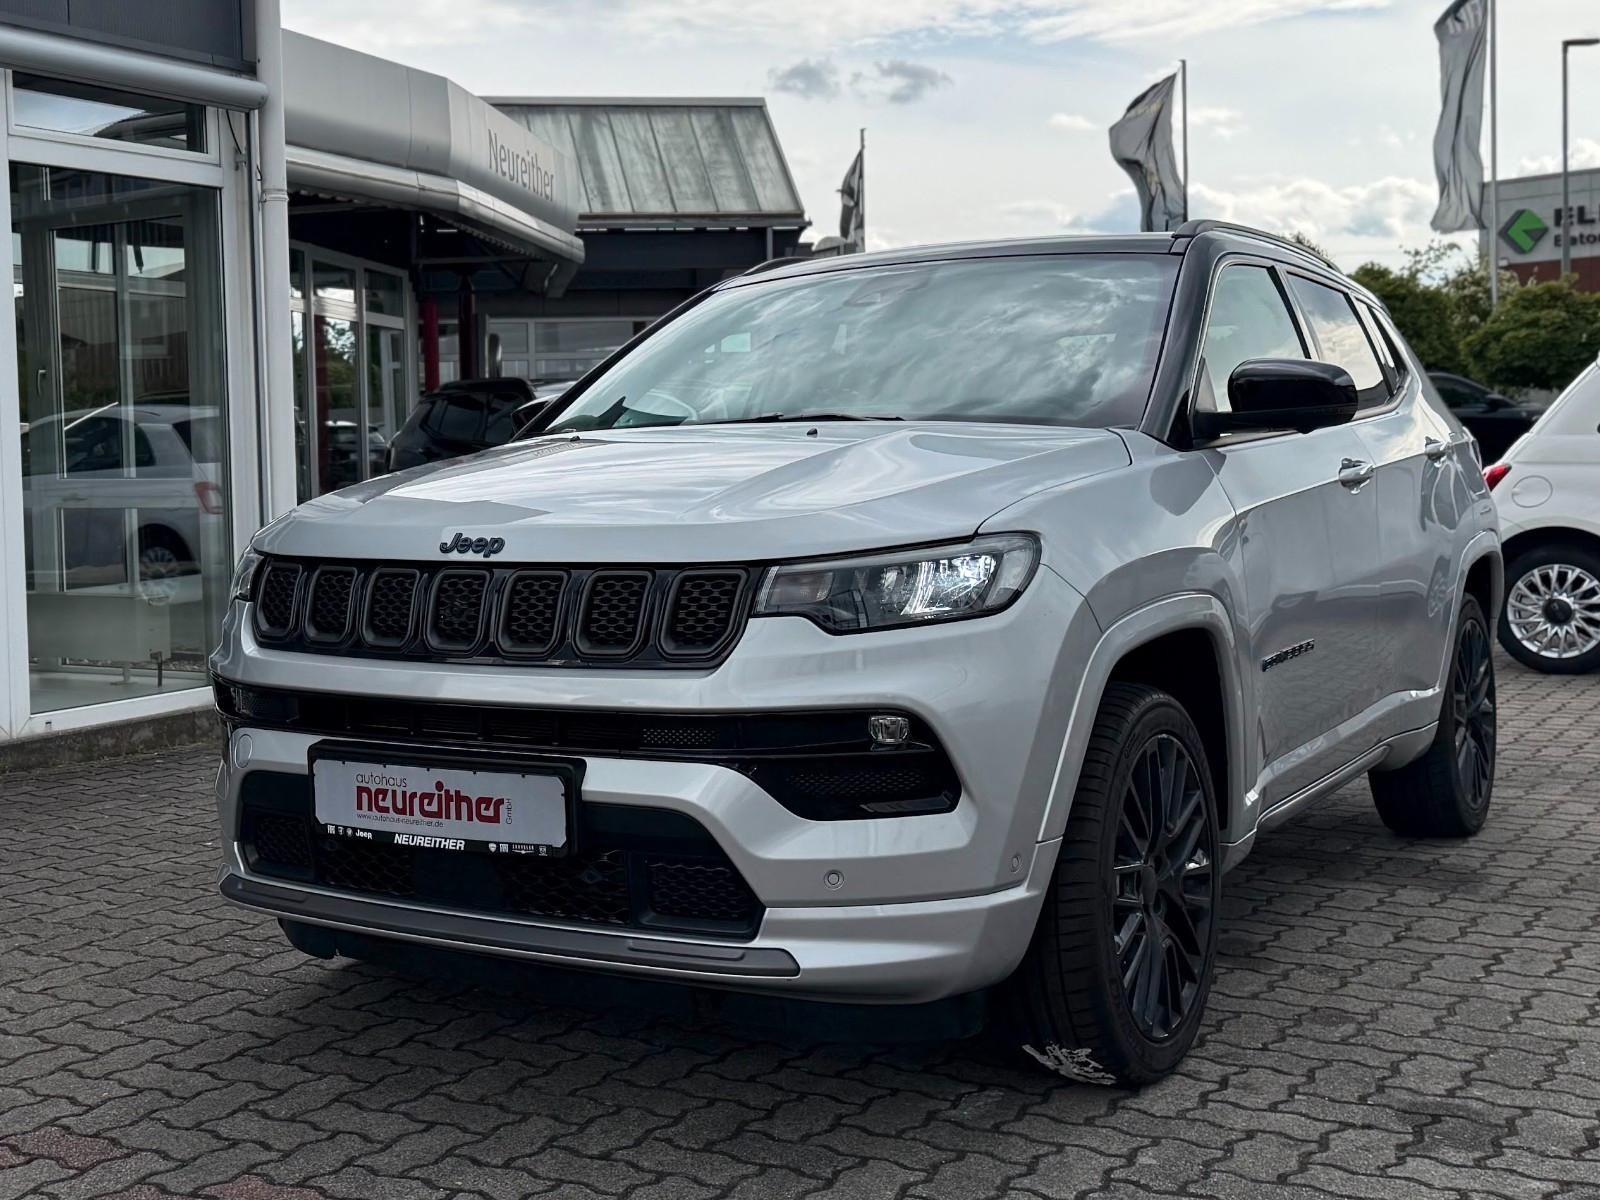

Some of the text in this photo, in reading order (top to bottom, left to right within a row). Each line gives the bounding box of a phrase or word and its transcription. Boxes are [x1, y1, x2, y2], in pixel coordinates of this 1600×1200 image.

[488, 128, 554, 202] Neureither
[439, 532, 506, 558] Jeep
[355, 771, 407, 788] autohaus
[356, 780, 505, 824] neureither
[505, 797, 513, 825] GmbH
[393, 833, 466, 851] NEUREITHER
